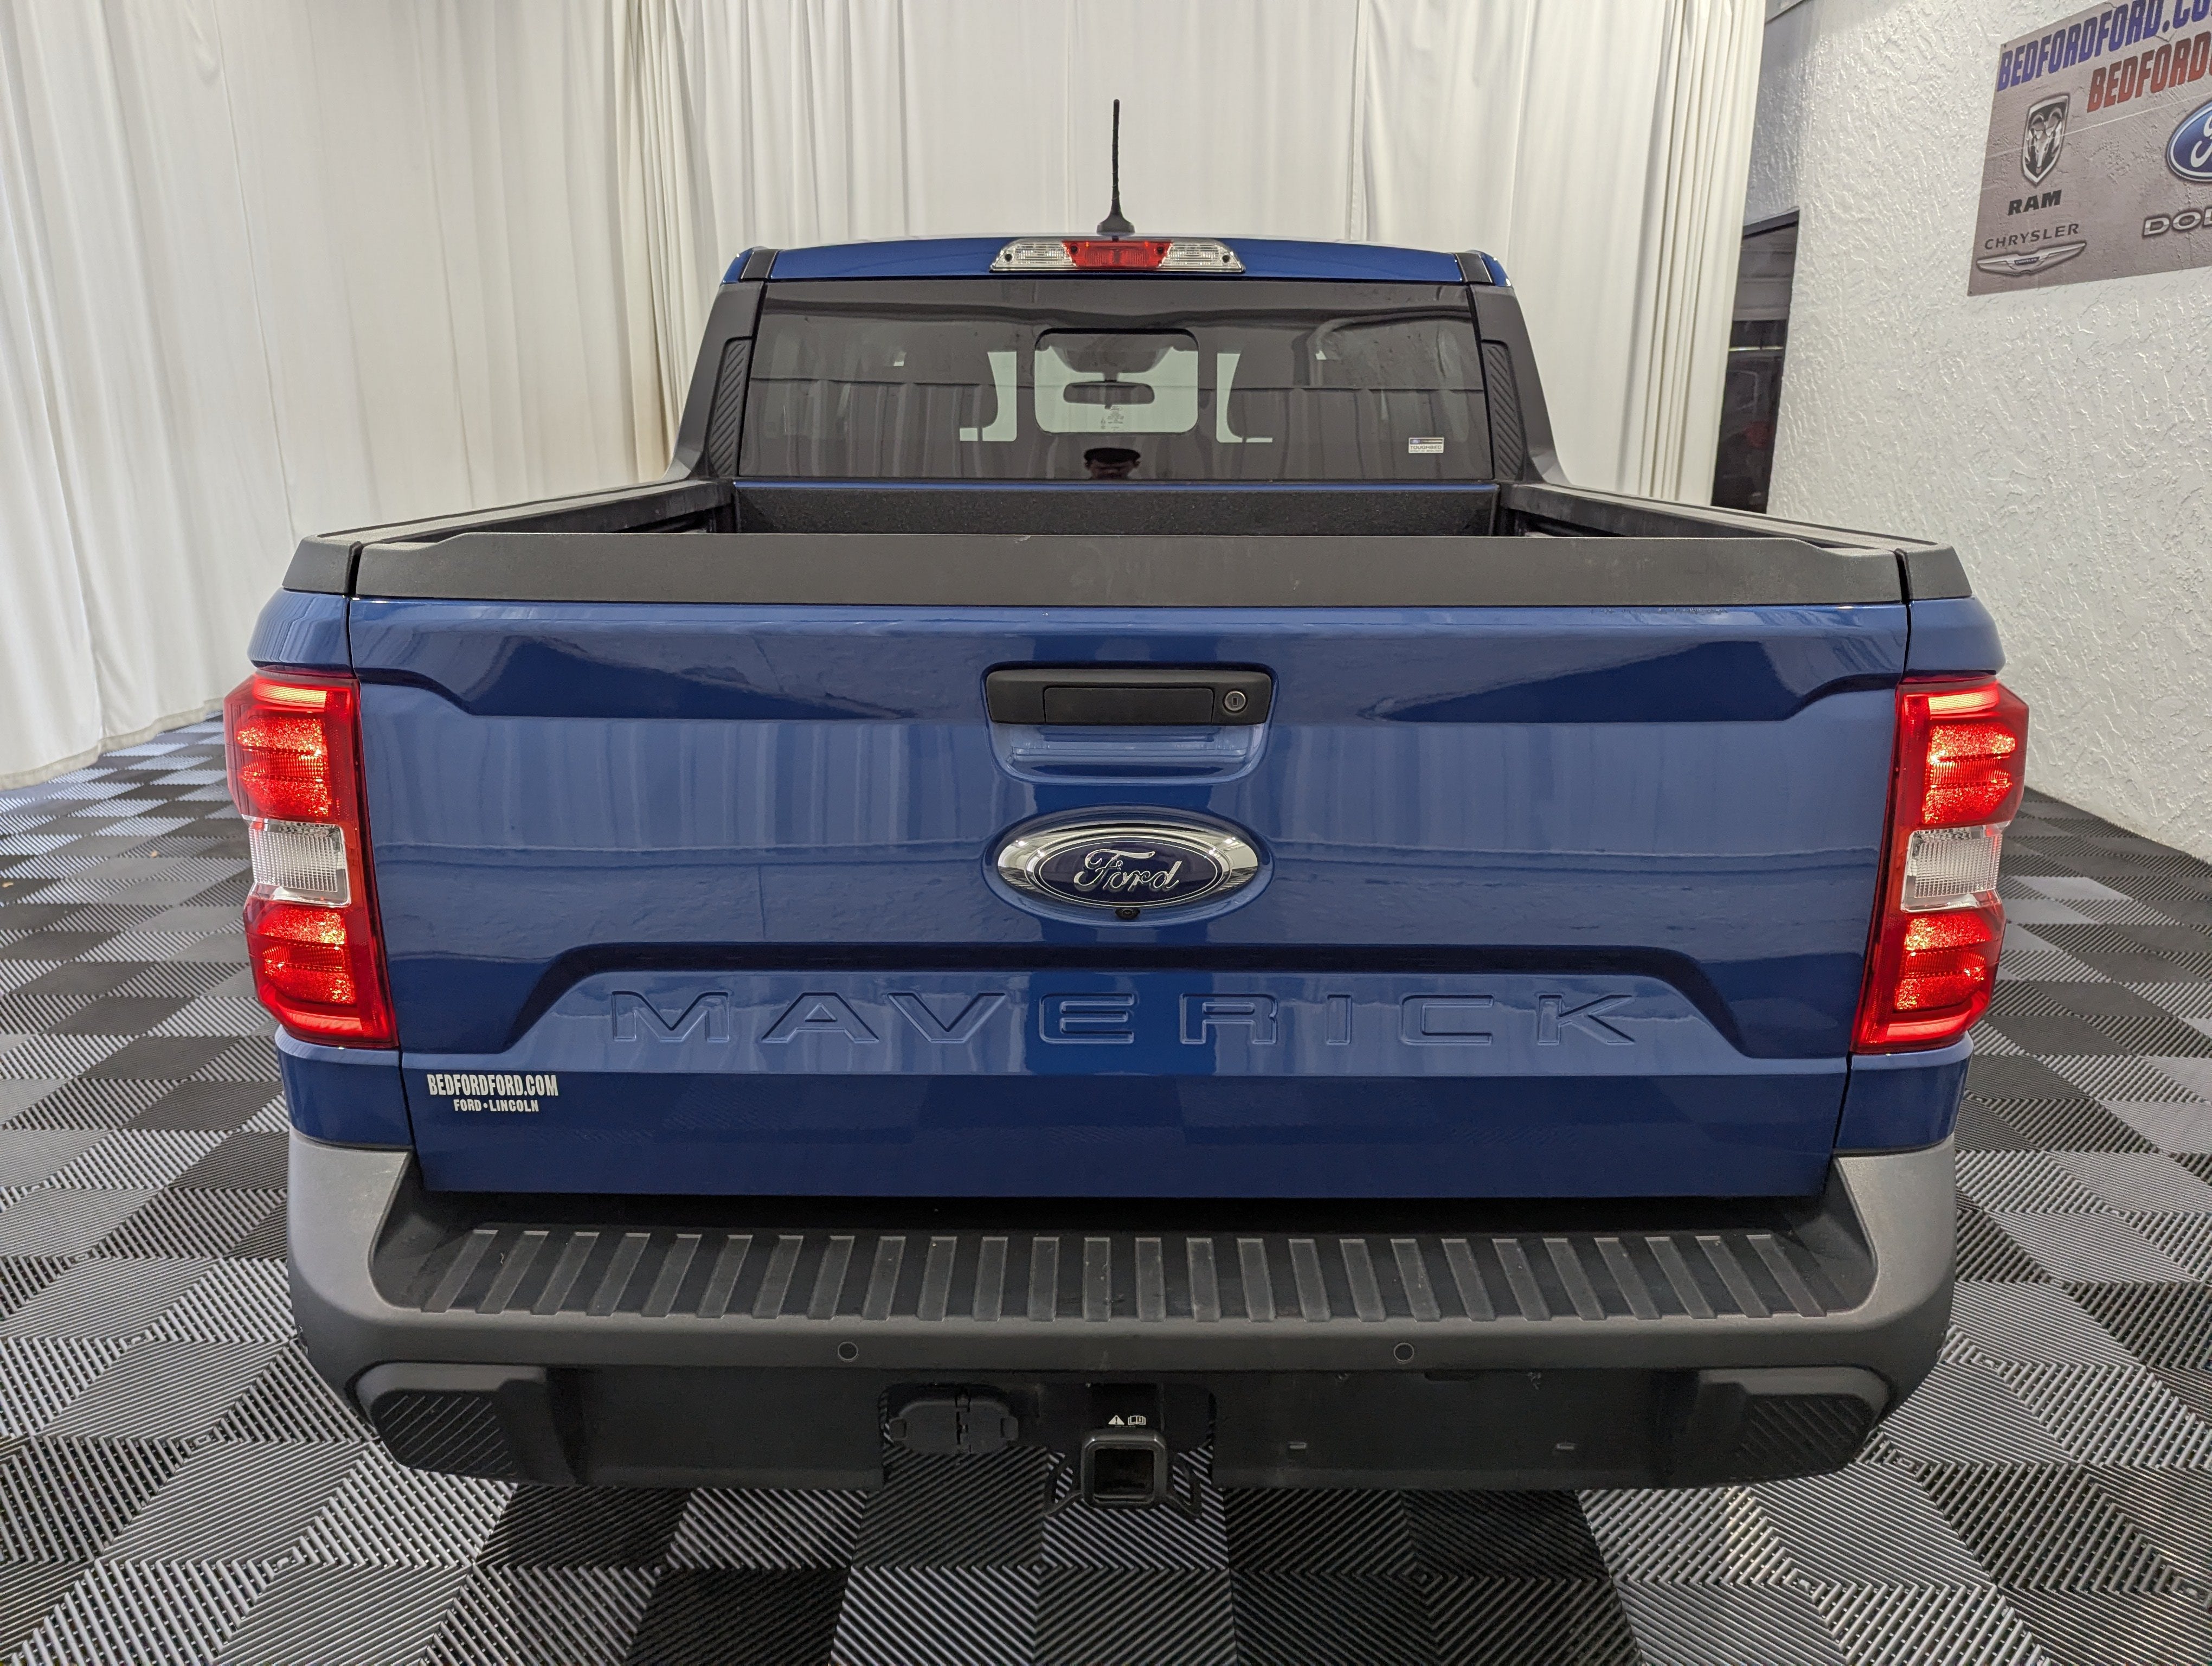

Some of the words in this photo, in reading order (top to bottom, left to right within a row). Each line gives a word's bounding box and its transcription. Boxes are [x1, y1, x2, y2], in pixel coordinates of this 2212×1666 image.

[2087, 31, 2212, 113] BEDFORD
[2008, 190, 2062, 216] RAM
[1984, 223, 2079, 250] CHRYSLER
[1074, 849, 1182, 892] Ford
[612, 991, 1636, 1045] MAVERICK
[427, 1074, 559, 1096] BEDFORDFORD.COM
